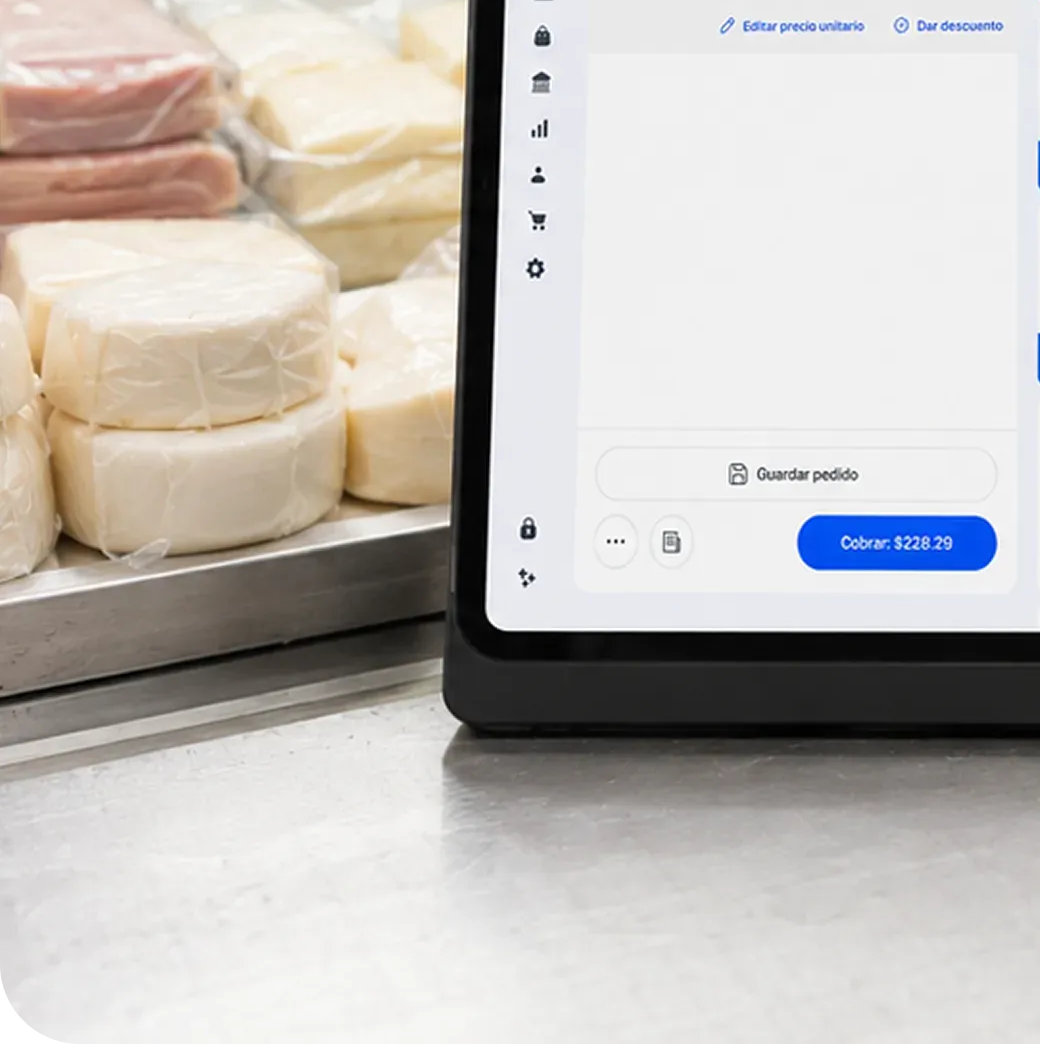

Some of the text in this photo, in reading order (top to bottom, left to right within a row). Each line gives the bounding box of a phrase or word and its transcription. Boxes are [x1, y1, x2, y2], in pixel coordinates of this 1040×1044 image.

[742, 19, 866, 35] Editar precio unitario
[916, 19, 1005, 32] Dar descuento
[756, 466, 860, 484] Guardar pedido
[840, 534, 954, 551] Cobrar: $228.29
